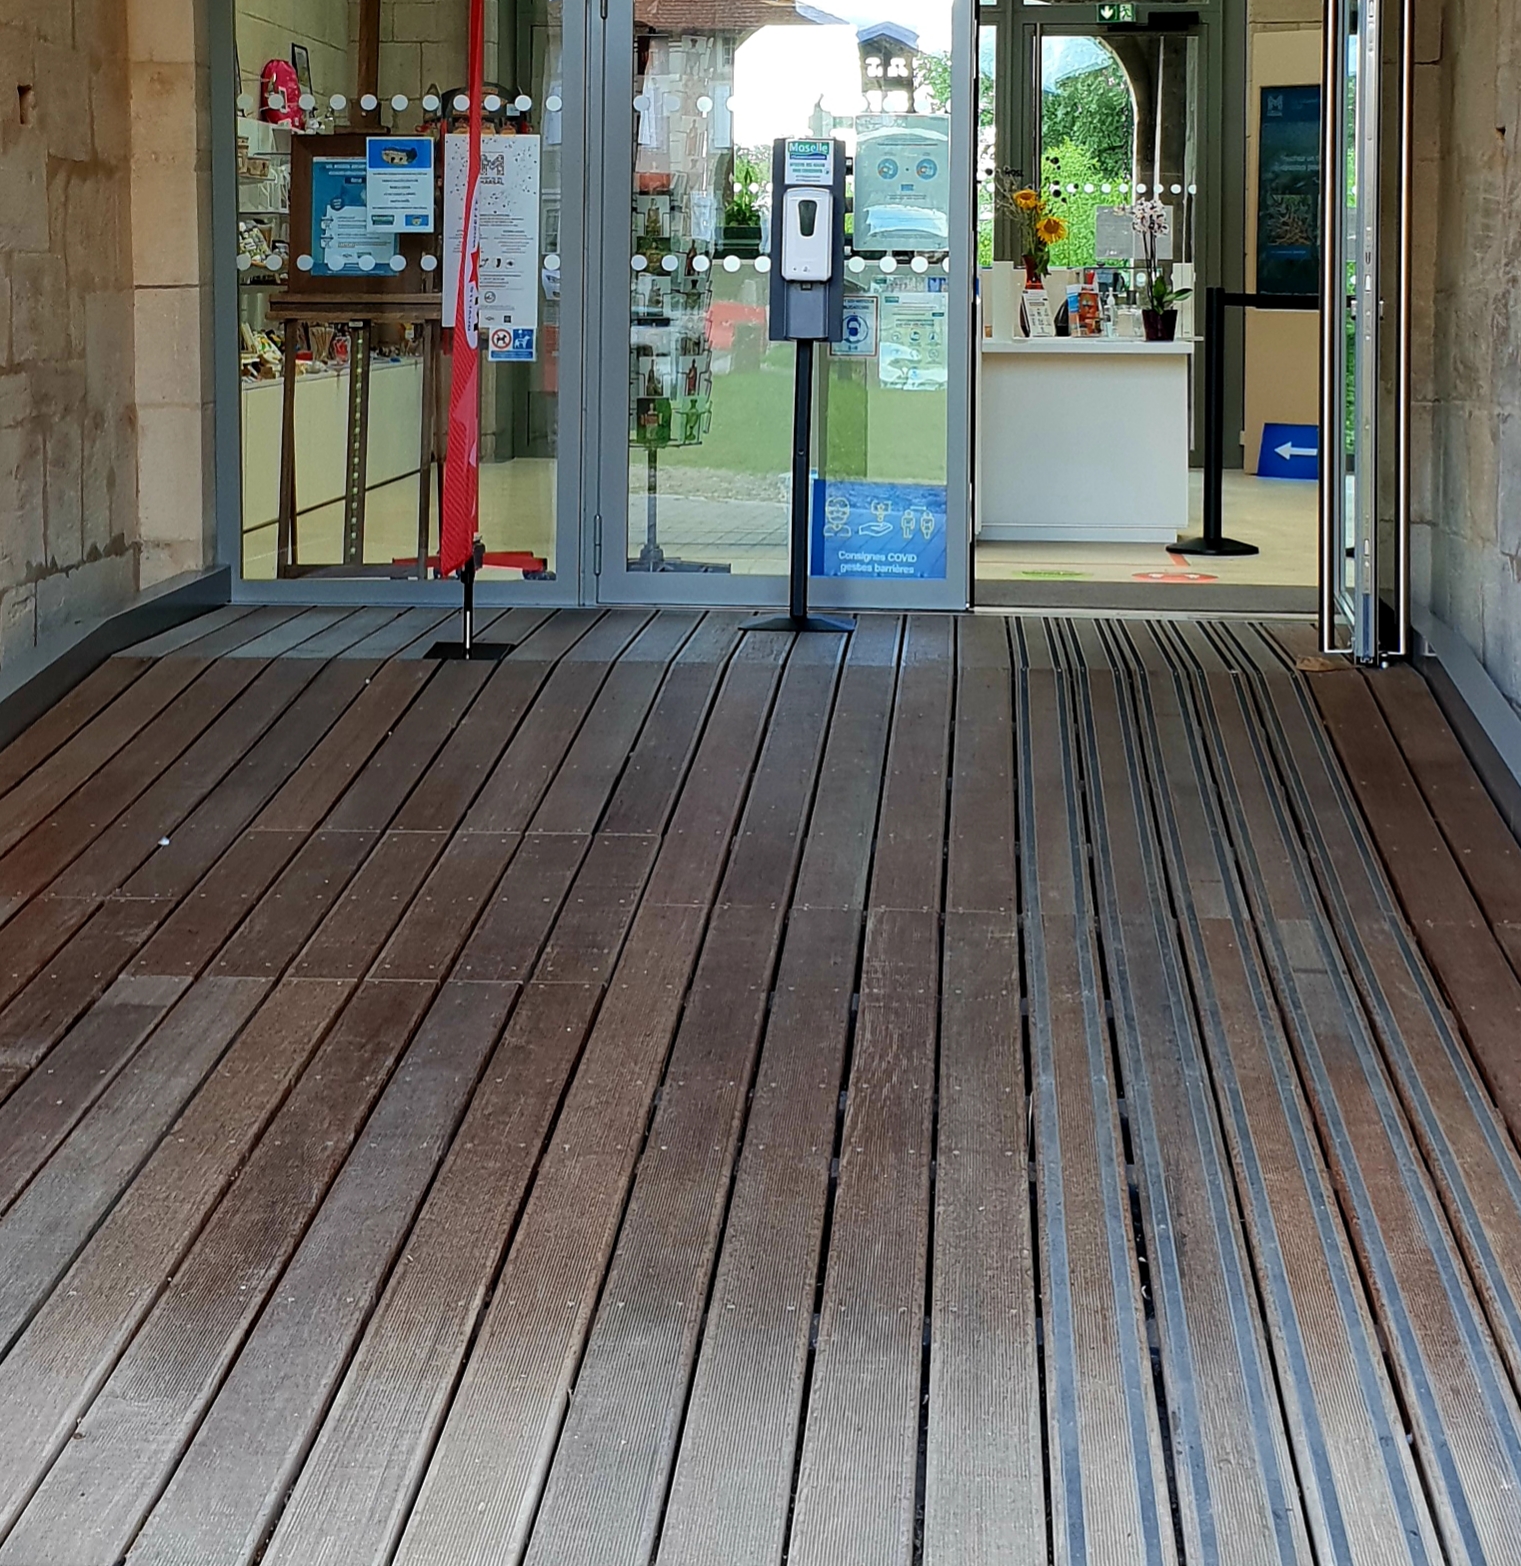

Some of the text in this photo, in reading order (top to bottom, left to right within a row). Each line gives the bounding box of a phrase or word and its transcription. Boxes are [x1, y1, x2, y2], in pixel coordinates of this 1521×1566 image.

[789, 142, 829, 153] Moselle
[838, 550, 917, 563] Consignes COVID
[840, 563, 915, 574] gestes barrières
